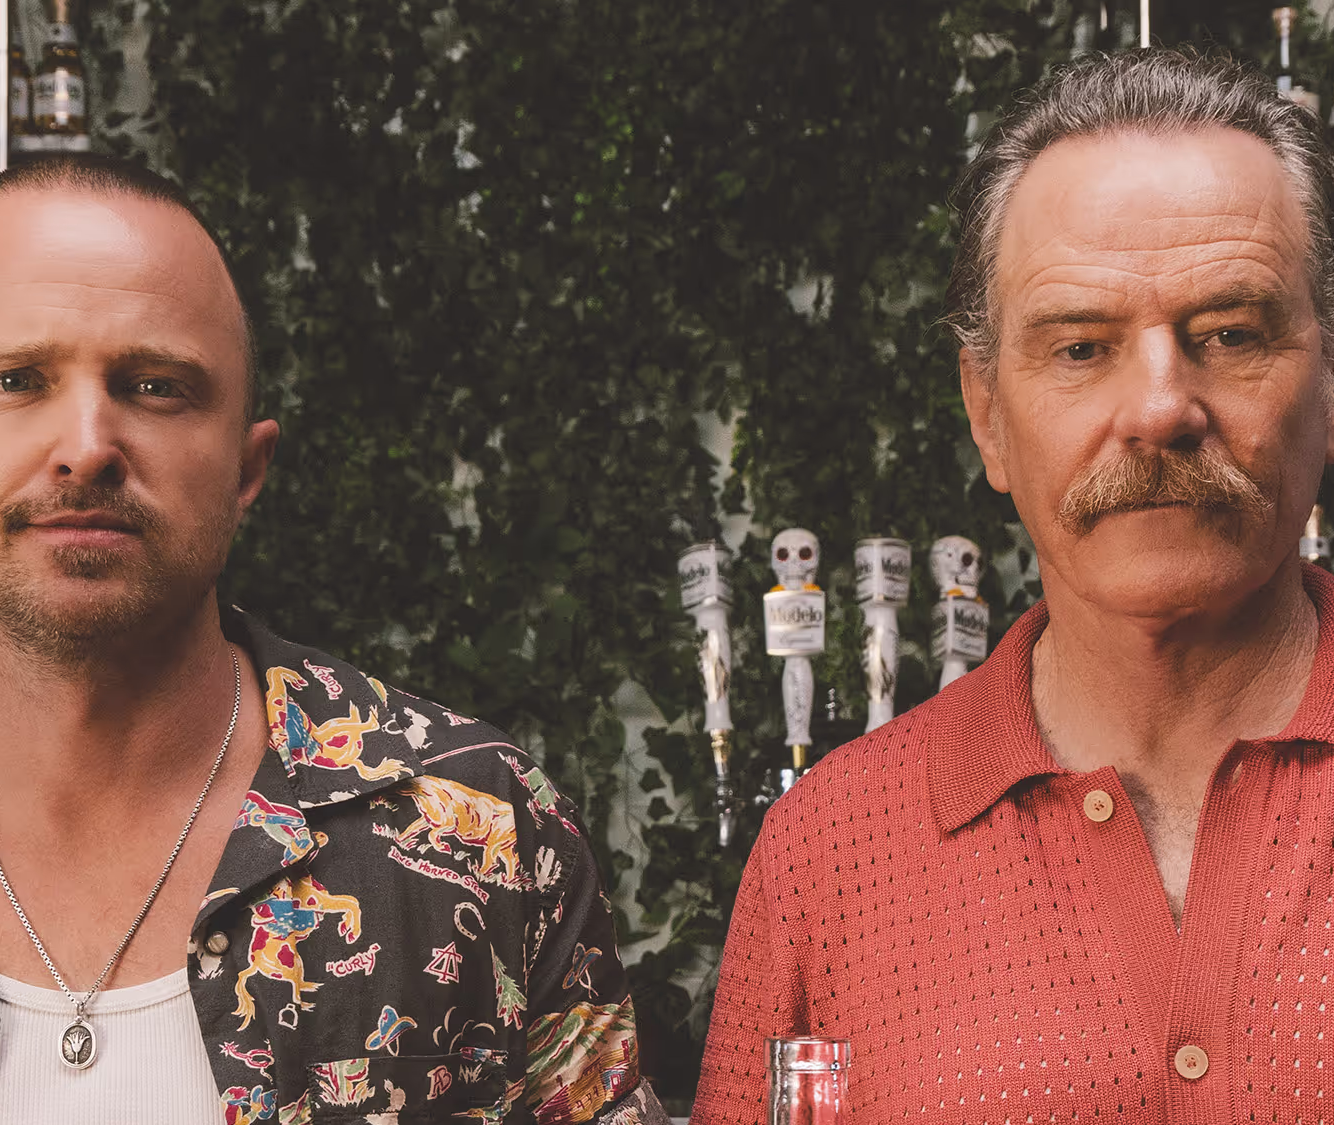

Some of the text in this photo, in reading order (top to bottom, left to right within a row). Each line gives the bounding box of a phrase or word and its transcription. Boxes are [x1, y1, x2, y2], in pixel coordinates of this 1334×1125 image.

[389, 847, 489, 904] LONG HORNED STEER
